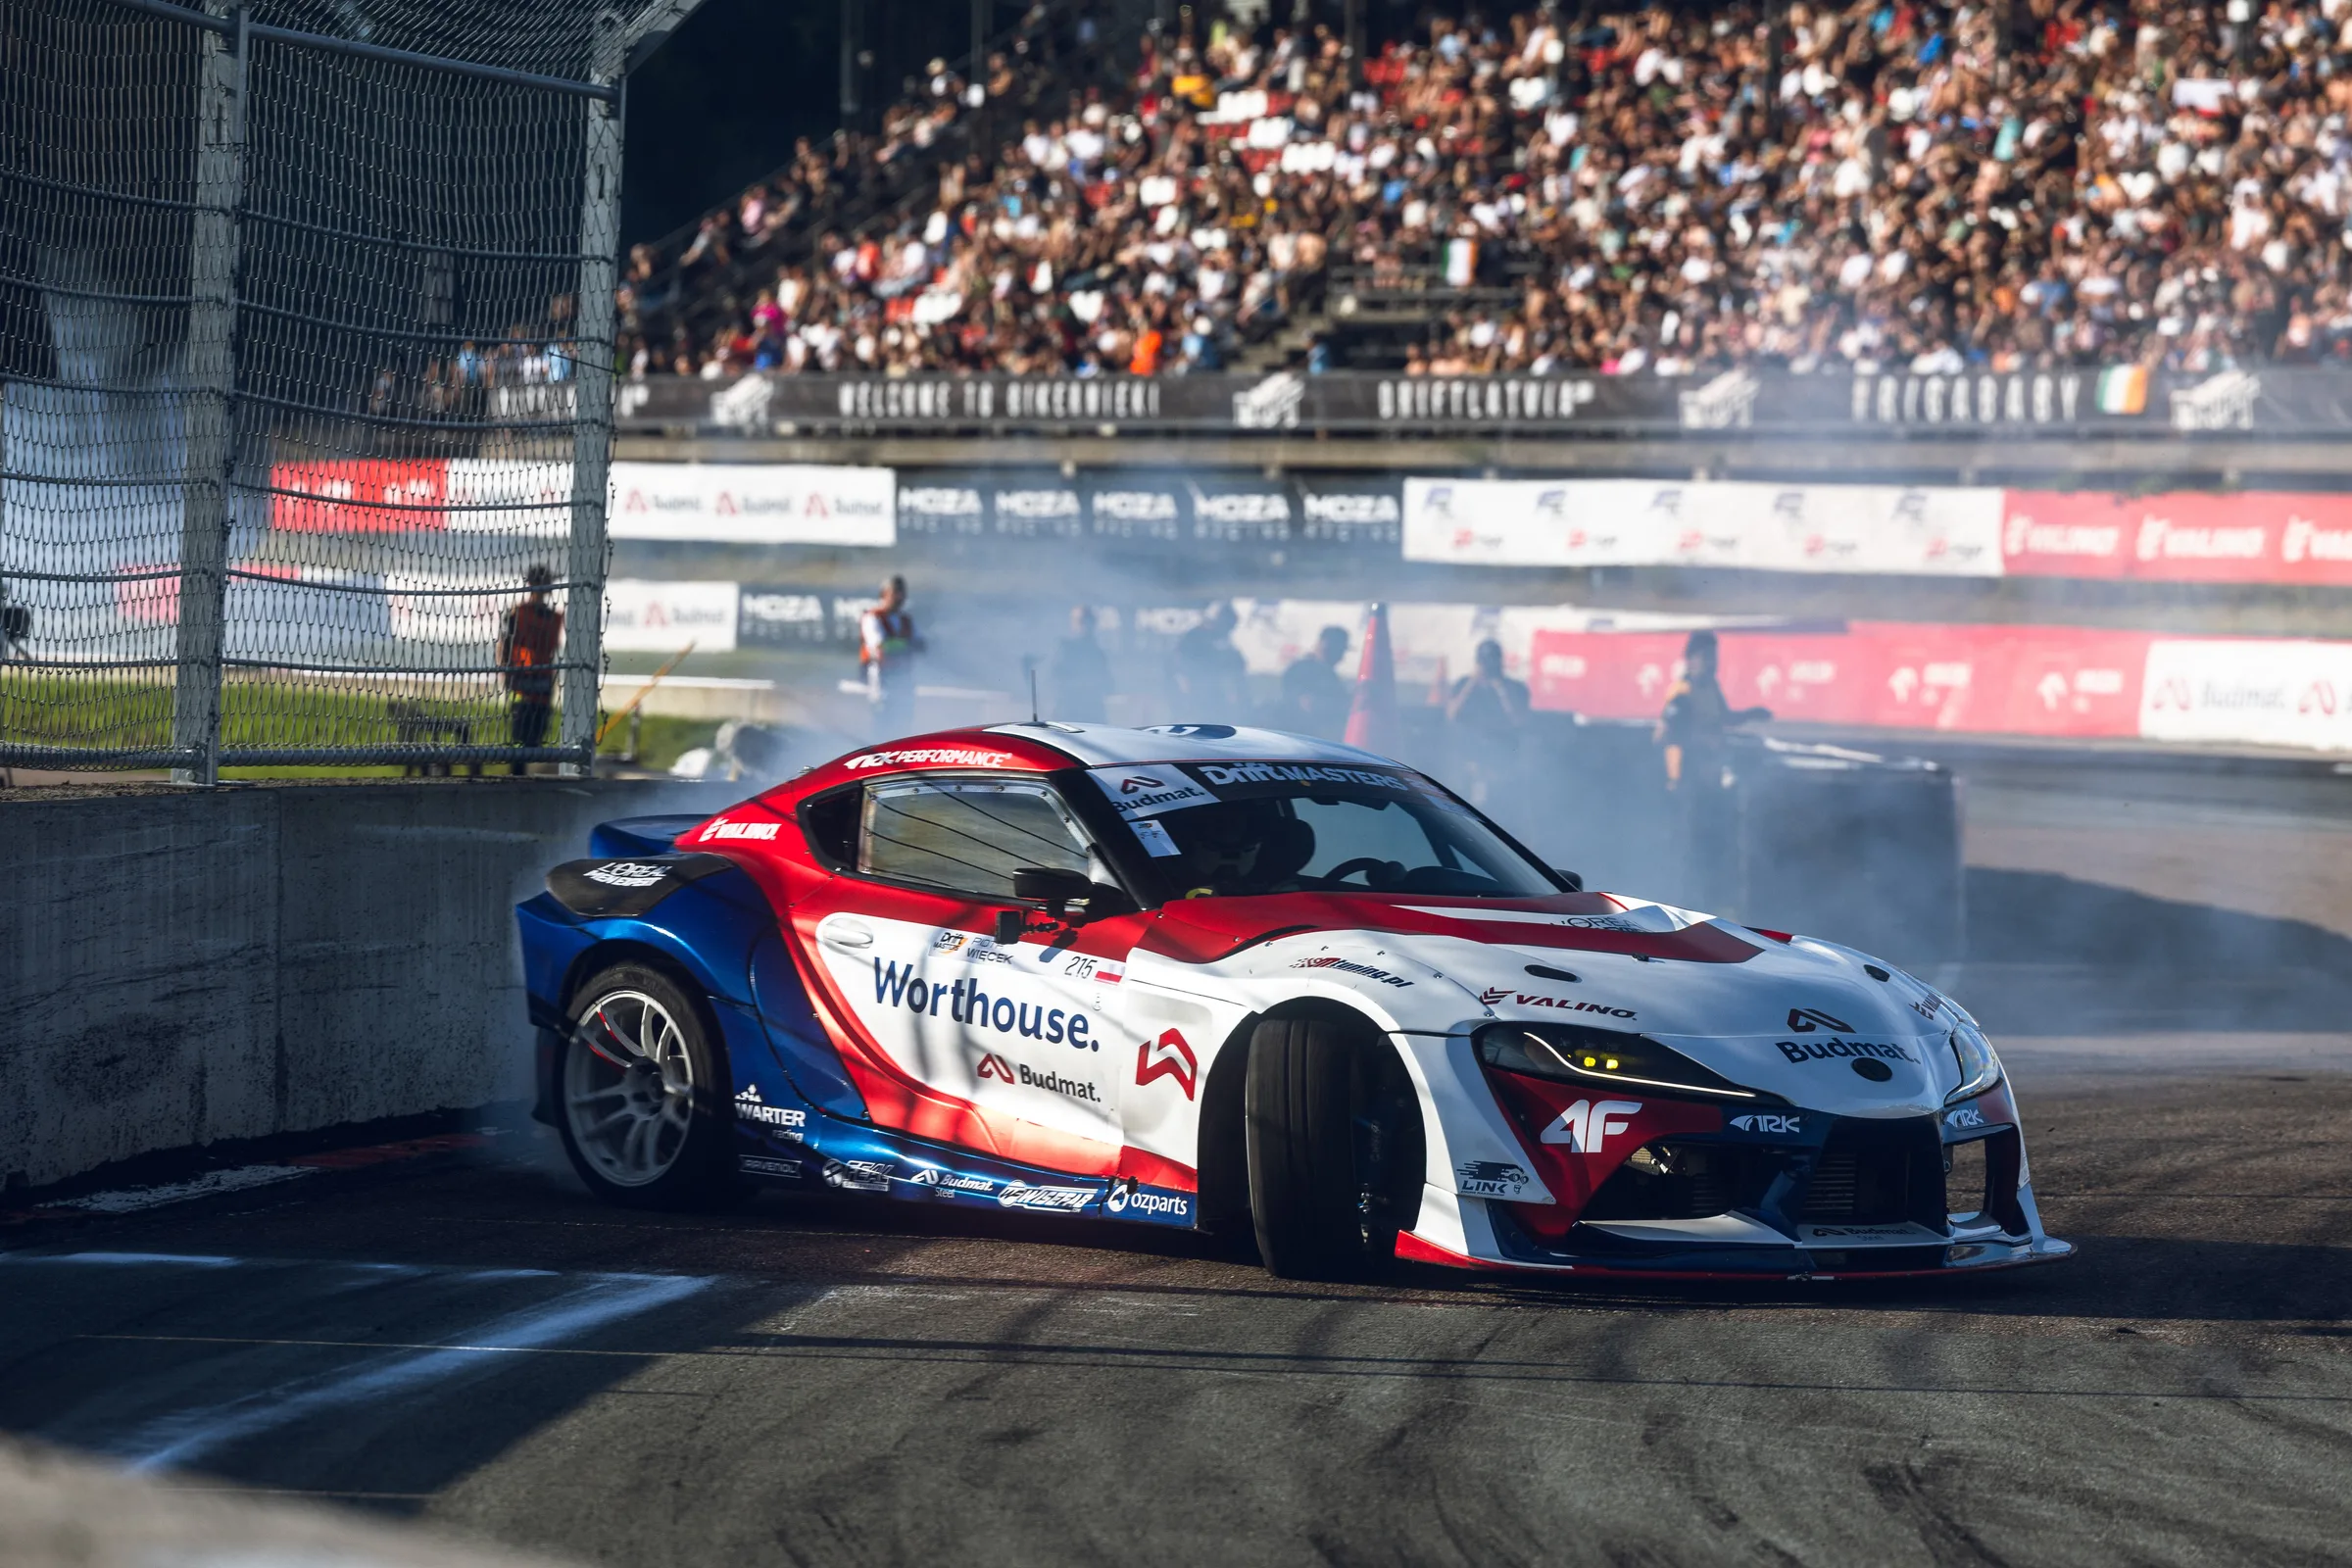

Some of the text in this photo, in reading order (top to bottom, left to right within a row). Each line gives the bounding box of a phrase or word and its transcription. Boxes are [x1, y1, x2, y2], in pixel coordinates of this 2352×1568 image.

[895, 749, 1005, 767] PERFORMANCE
[874, 956, 1100, 1053] Worthouse.
[1019, 1063, 1102, 1102] Budmat.
[734, 1102, 807, 1127] WARTER
[1461, 1180, 1508, 1194] LINK
[1131, 1193, 1188, 1215] ozparts
